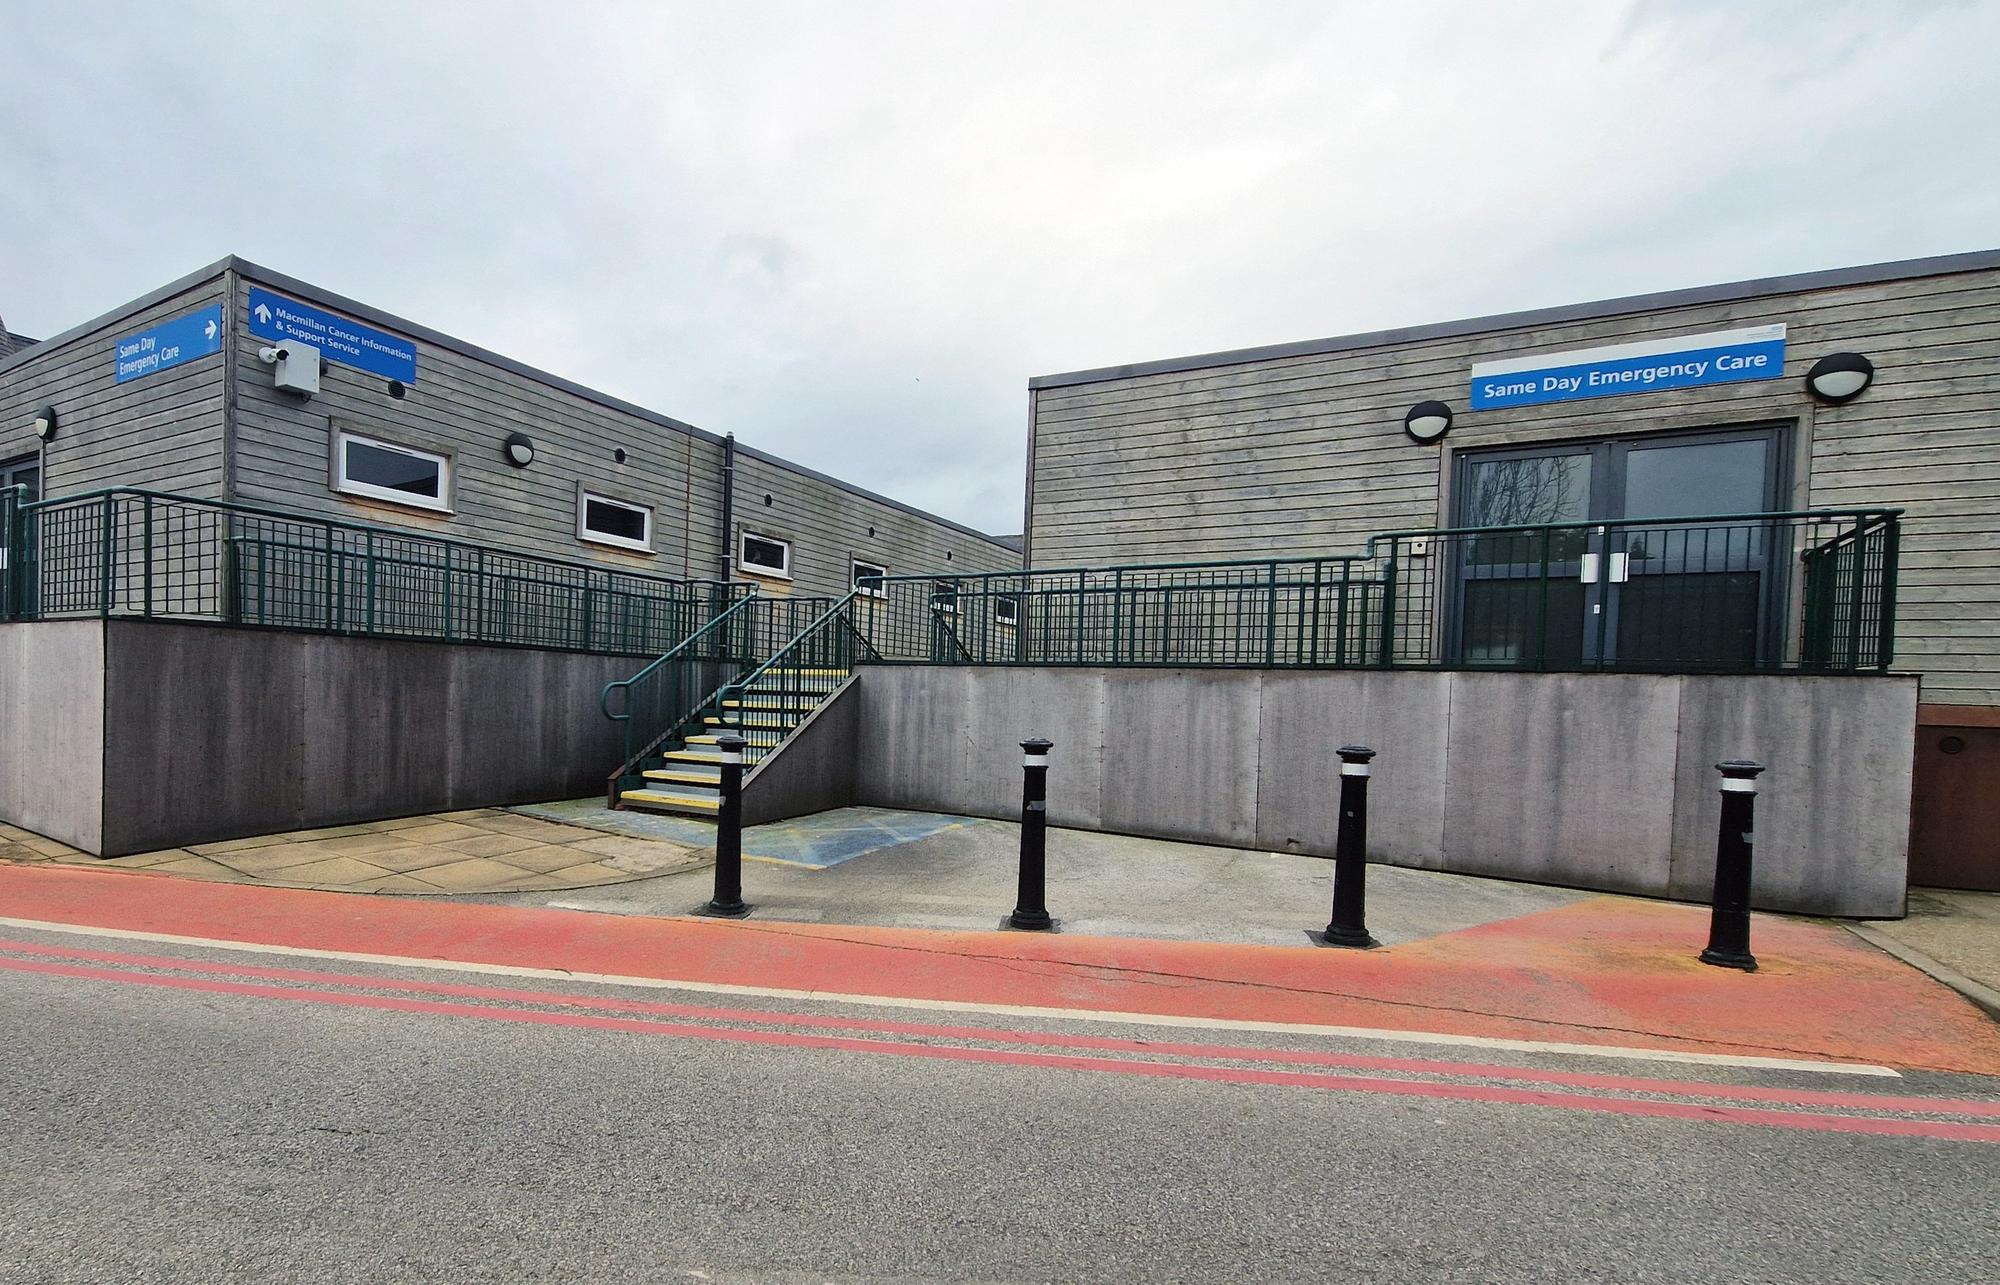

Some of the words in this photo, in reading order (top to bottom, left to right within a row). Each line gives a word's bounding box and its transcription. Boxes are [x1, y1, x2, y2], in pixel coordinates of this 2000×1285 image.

[120, 342, 140, 358] Same
[141, 337, 156, 351] Day
[276, 308, 326, 332] Macmillan
[328, 326, 359, 343] Cancer
[361, 337, 412, 361] Information
[276, 321, 283, 331] &
[286, 324, 326, 344] Support
[327, 338, 360, 356] Service
[120, 352, 160, 375] Emergency
[161, 345, 179, 360] Care
[1484, 381, 1536, 398] Same
[1543, 376, 1582, 392] Day
[1589, 361, 1709, 386] Emergency
[1716, 354, 1768, 371] Care
